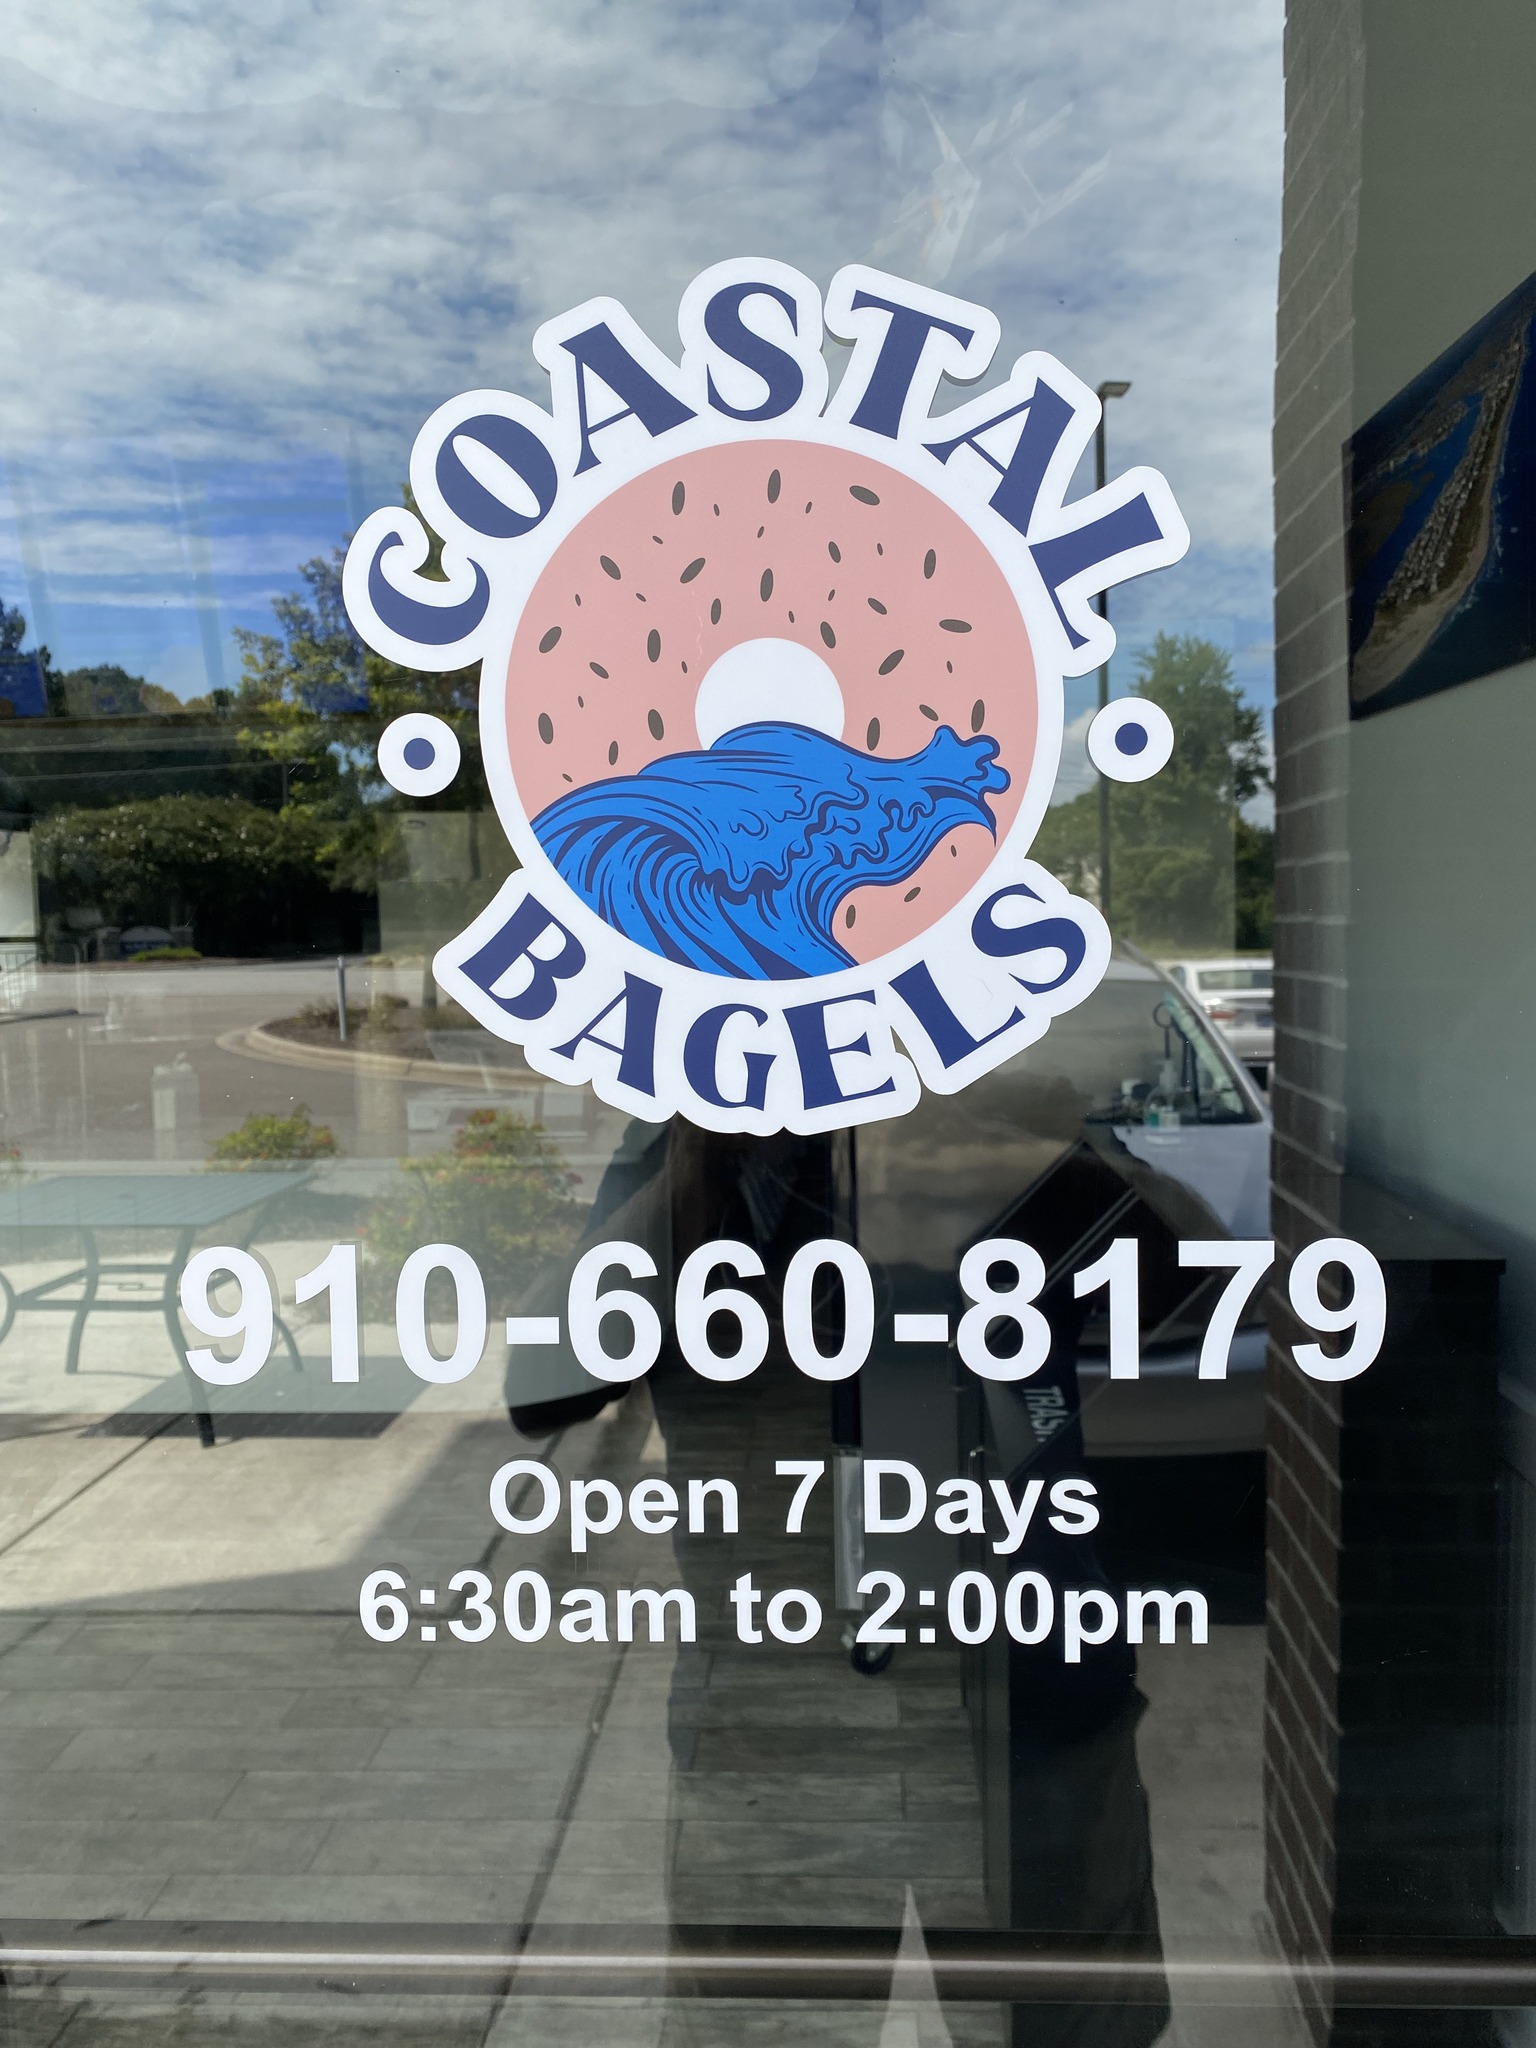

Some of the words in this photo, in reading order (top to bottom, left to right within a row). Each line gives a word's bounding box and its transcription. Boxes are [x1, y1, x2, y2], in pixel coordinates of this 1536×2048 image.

[368, 283, 1163, 648] COASTAL
[459, 884, 1087, 1110] BAGELS
[180, 1238, 1387, 1386] 910-660-8179
[489, 1460, 739, 1553] Open
[776, 1461, 825, 1533] 7
[863, 1460, 1100, 1555] Days
[360, 1569, 696, 1643] 6:30am
[729, 1572, 822, 1644] to
[856, 1570, 1208, 1663] 2:00pm
